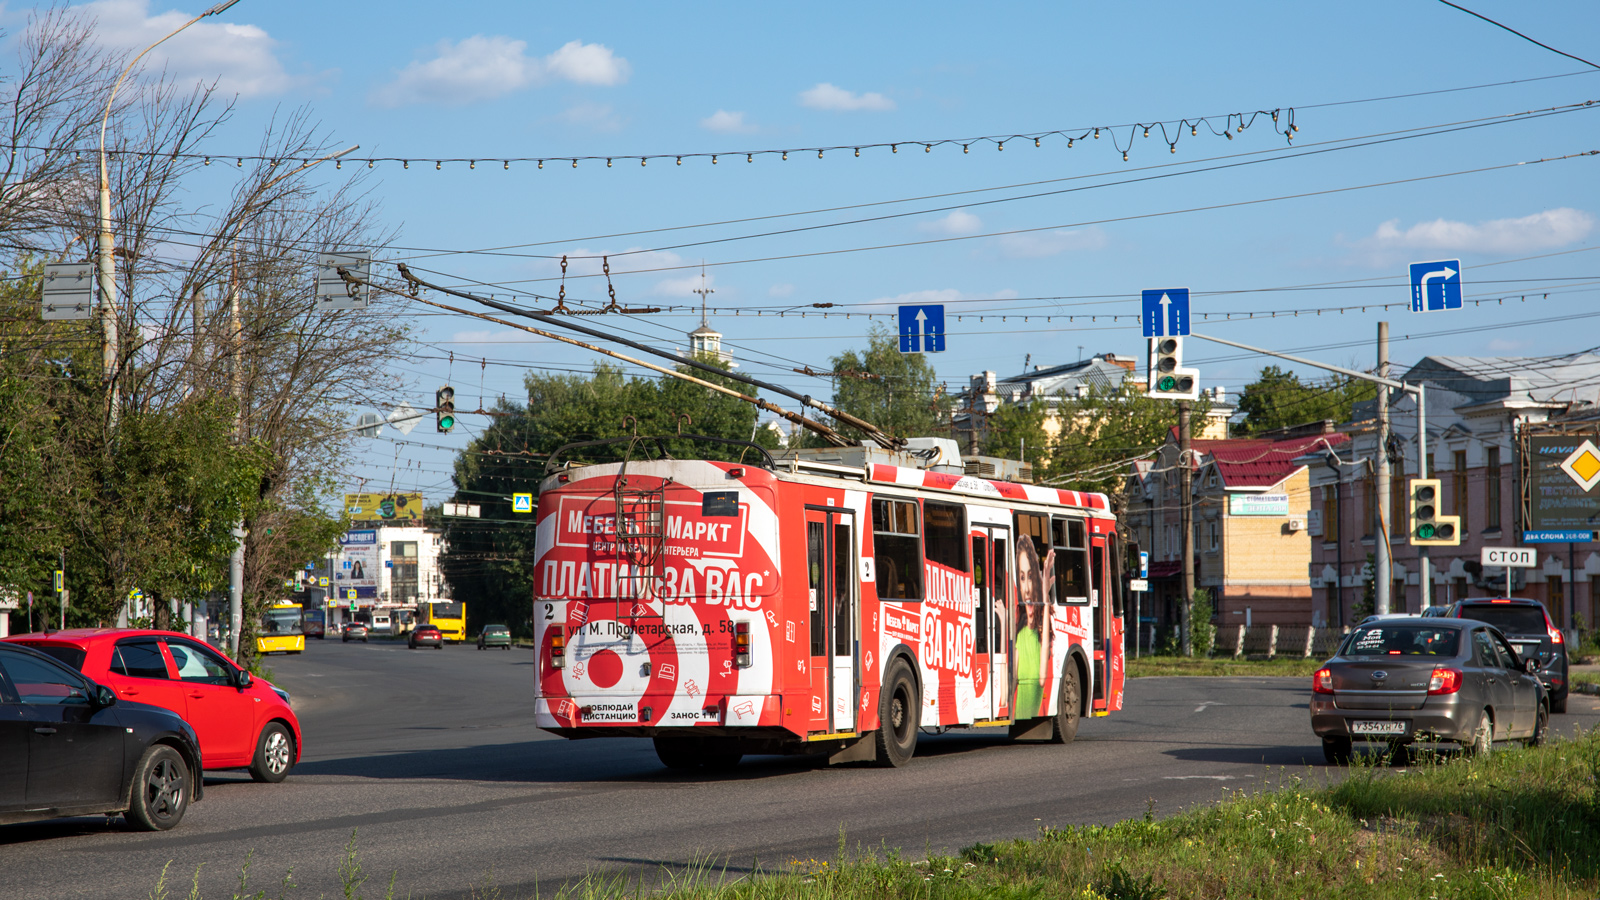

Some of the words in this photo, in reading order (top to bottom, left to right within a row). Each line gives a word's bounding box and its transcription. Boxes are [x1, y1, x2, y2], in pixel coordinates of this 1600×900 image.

[1539, 446, 1579, 454] HAVA
[592, 541, 615, 551] ЦЕНТР
[660, 545, 699, 557] НТЕРЬЕРА
[1489, 551, 1529, 563] СТОП
[661, 566, 697, 603] ЗА
[544, 603, 554, 620] 2
[568, 625, 585, 639] ул.
[589, 622, 603, 636] М.
[607, 621, 698, 638] Пролетарская,
[702, 624, 715, 636] д.
[925, 616, 943, 668] ЗА
[946, 622, 971, 674] ВАС
[587, 703, 634, 712] ОБЛЮДАЙ
[584, 713, 636, 721] ДИСТАНЦИЮ
